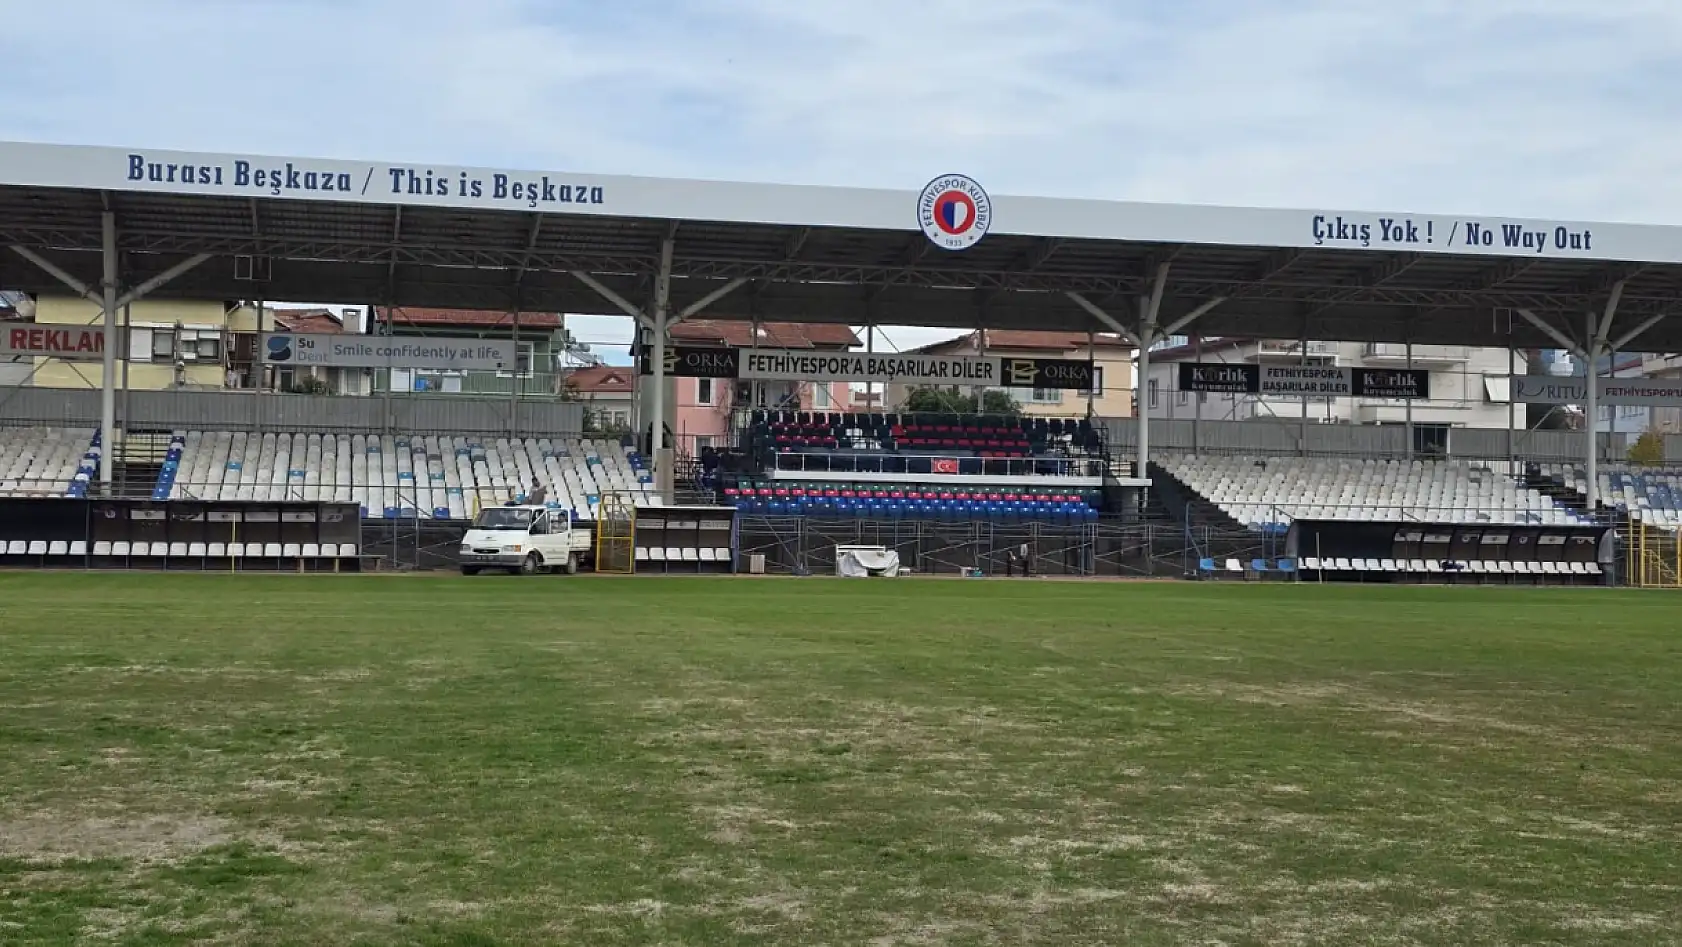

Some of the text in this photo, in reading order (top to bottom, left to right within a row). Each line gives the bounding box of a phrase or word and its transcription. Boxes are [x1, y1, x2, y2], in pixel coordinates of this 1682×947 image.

[128, 154, 604, 208] Burası Beşkaza / This is Beşkaza
[1312, 215, 1371, 247] Çıkış
[1465, 222, 1493, 246] No
[1501, 224, 1547, 253] Way
[1555, 226, 1592, 250] Out
[298, 337, 315, 349] Su
[298, 351, 327, 362] Dent
[334, 344, 503, 361] Smile confidently at life.
[686, 352, 734, 367] ORKA
[748, 351, 993, 380] FETHİYESPOR'A BAŞARILAR DİLER
[1044, 365, 1089, 380] ORKA
[1320, 381, 1349, 393] DİLER
